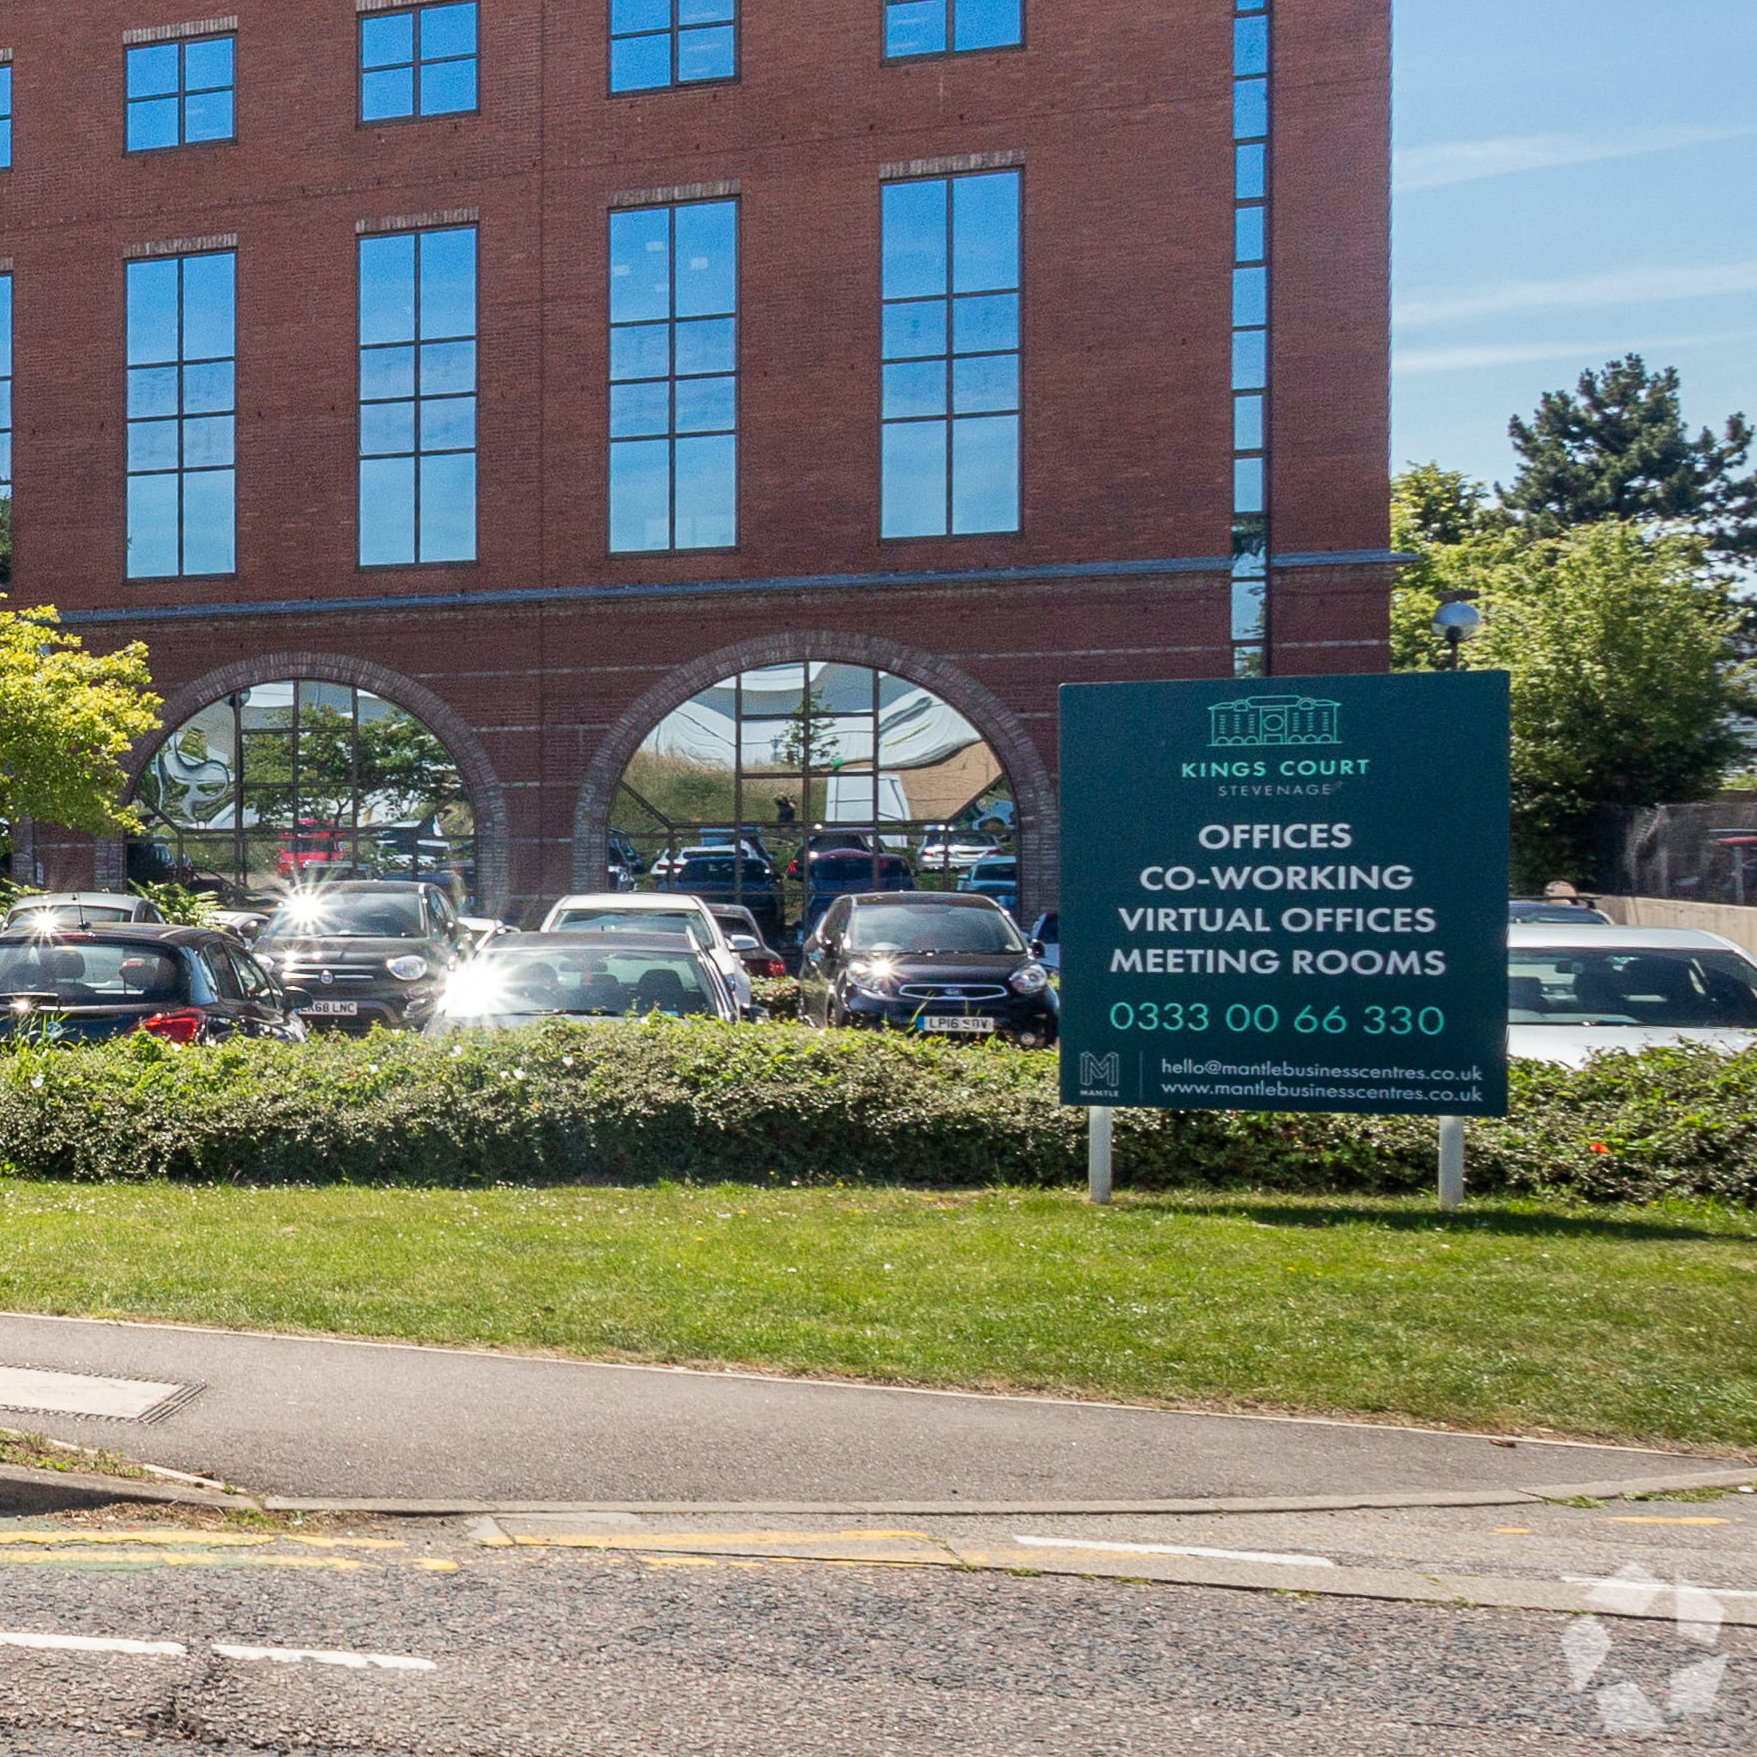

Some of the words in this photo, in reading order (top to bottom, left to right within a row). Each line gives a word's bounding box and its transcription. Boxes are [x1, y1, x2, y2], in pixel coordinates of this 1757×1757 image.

[1182, 761, 1267, 778] KINGS
[1279, 759, 1370, 776] COURT
[1218, 783, 1332, 797] STEVENAGE
[1198, 823, 1352, 850] OFFICES
[1139, 864, 1413, 891] CO-WORKING
[1118, 907, 1271, 932] VIRTUAL
[1281, 907, 1436, 933] OFFICES
[1110, 948, 1280, 974] MEETING
[1292, 949, 1446, 976] ROOMS
[1110, 1001, 1209, 1031] 0333
[1225, 1003, 1279, 1033] 00
[1293, 1004, 1347, 1034] 66
[1363, 1005, 1445, 1036] 330
[1161, 1058, 1483, 1081] hello@mantlebusinesscentres.co.uk
[1160, 1079, 1484, 1102] www.mantlebusinesscentres.co.uk
